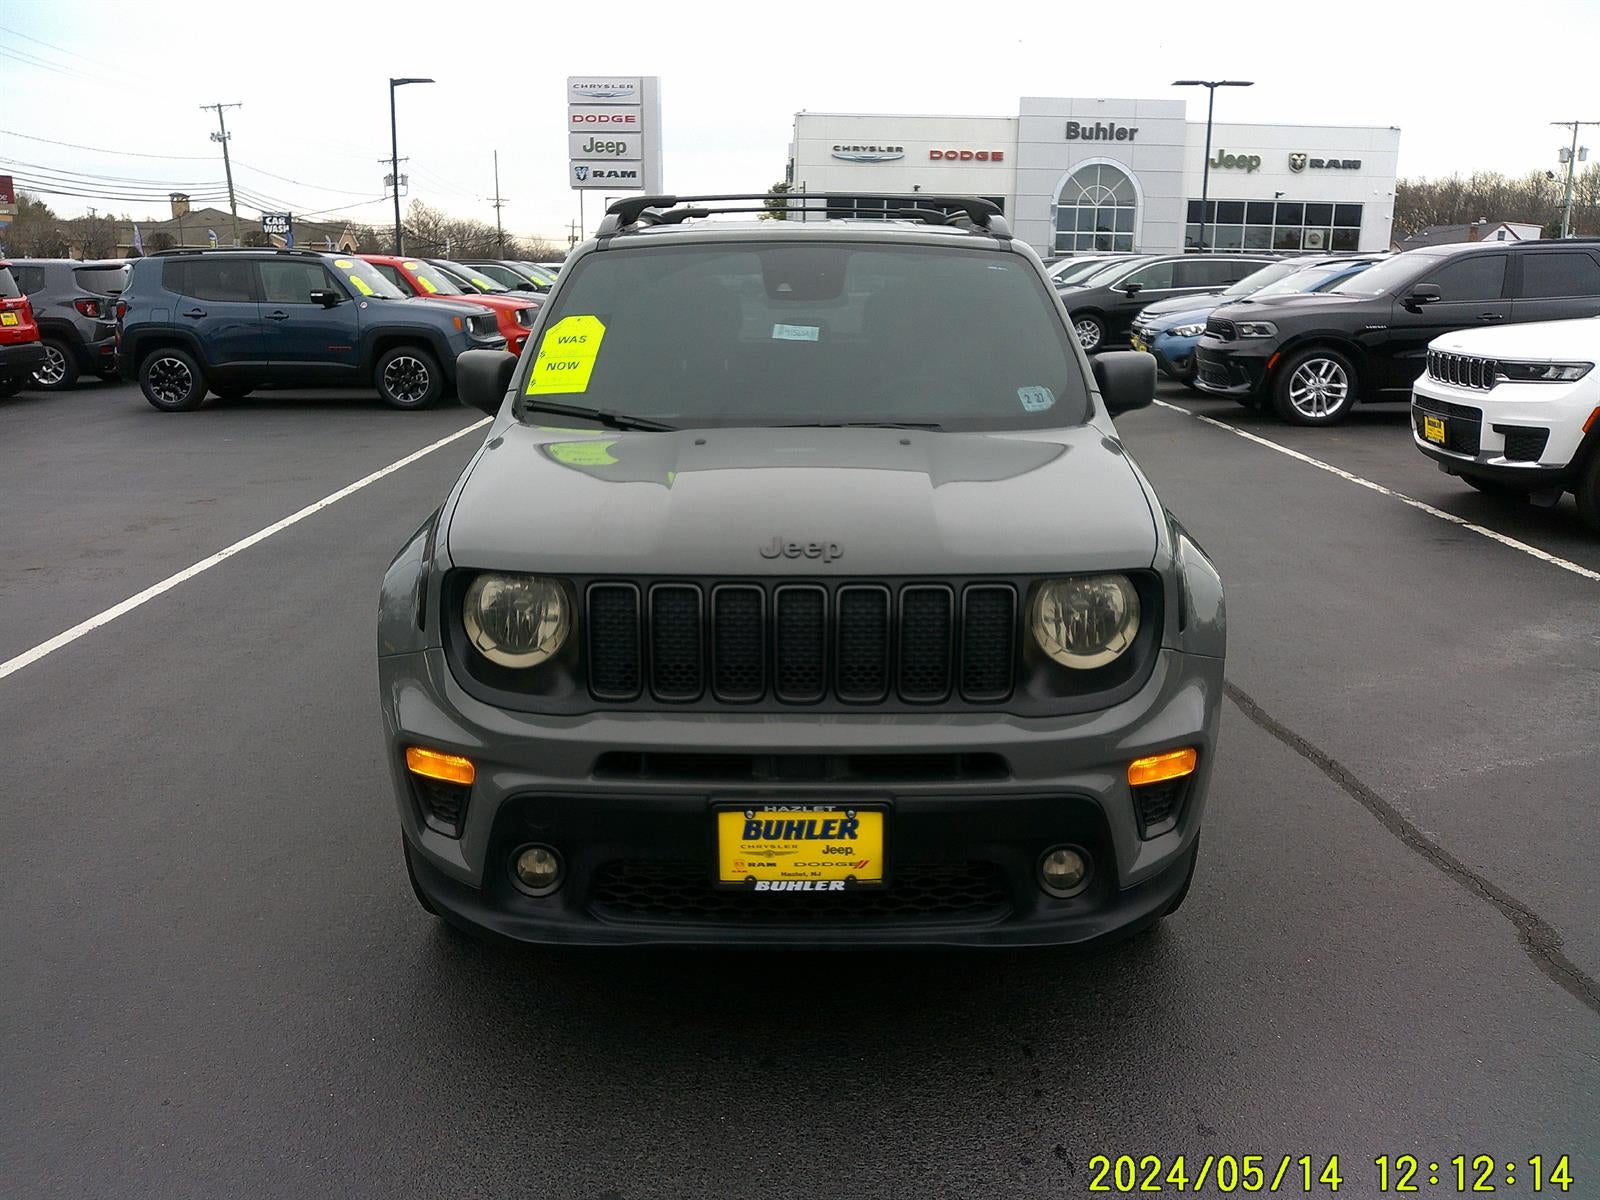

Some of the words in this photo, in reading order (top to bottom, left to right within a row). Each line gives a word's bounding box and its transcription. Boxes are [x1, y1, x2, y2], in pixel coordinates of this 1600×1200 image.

[572, 114, 637, 123] DODGE
[1066, 121, 1139, 141] Buhler
[582, 136, 627, 156] Jeep
[832, 145, 904, 153] CHRYSLER
[929, 150, 1005, 162] DODGE
[1209, 149, 1261, 173] Jeep
[1309, 158, 1362, 170] RAM
[592, 170, 637, 179] RAM
[265, 217, 286, 225] CAR
[263, 225, 289, 233] WASH
[558, 335, 587, 344] WAS
[546, 361, 580, 371] NOW
[759, 536, 844, 563] Jeep
[742, 818, 859, 840] BUHLER
[821, 844, 854, 856] Jeep
[754, 880, 846, 891] BUHLER
